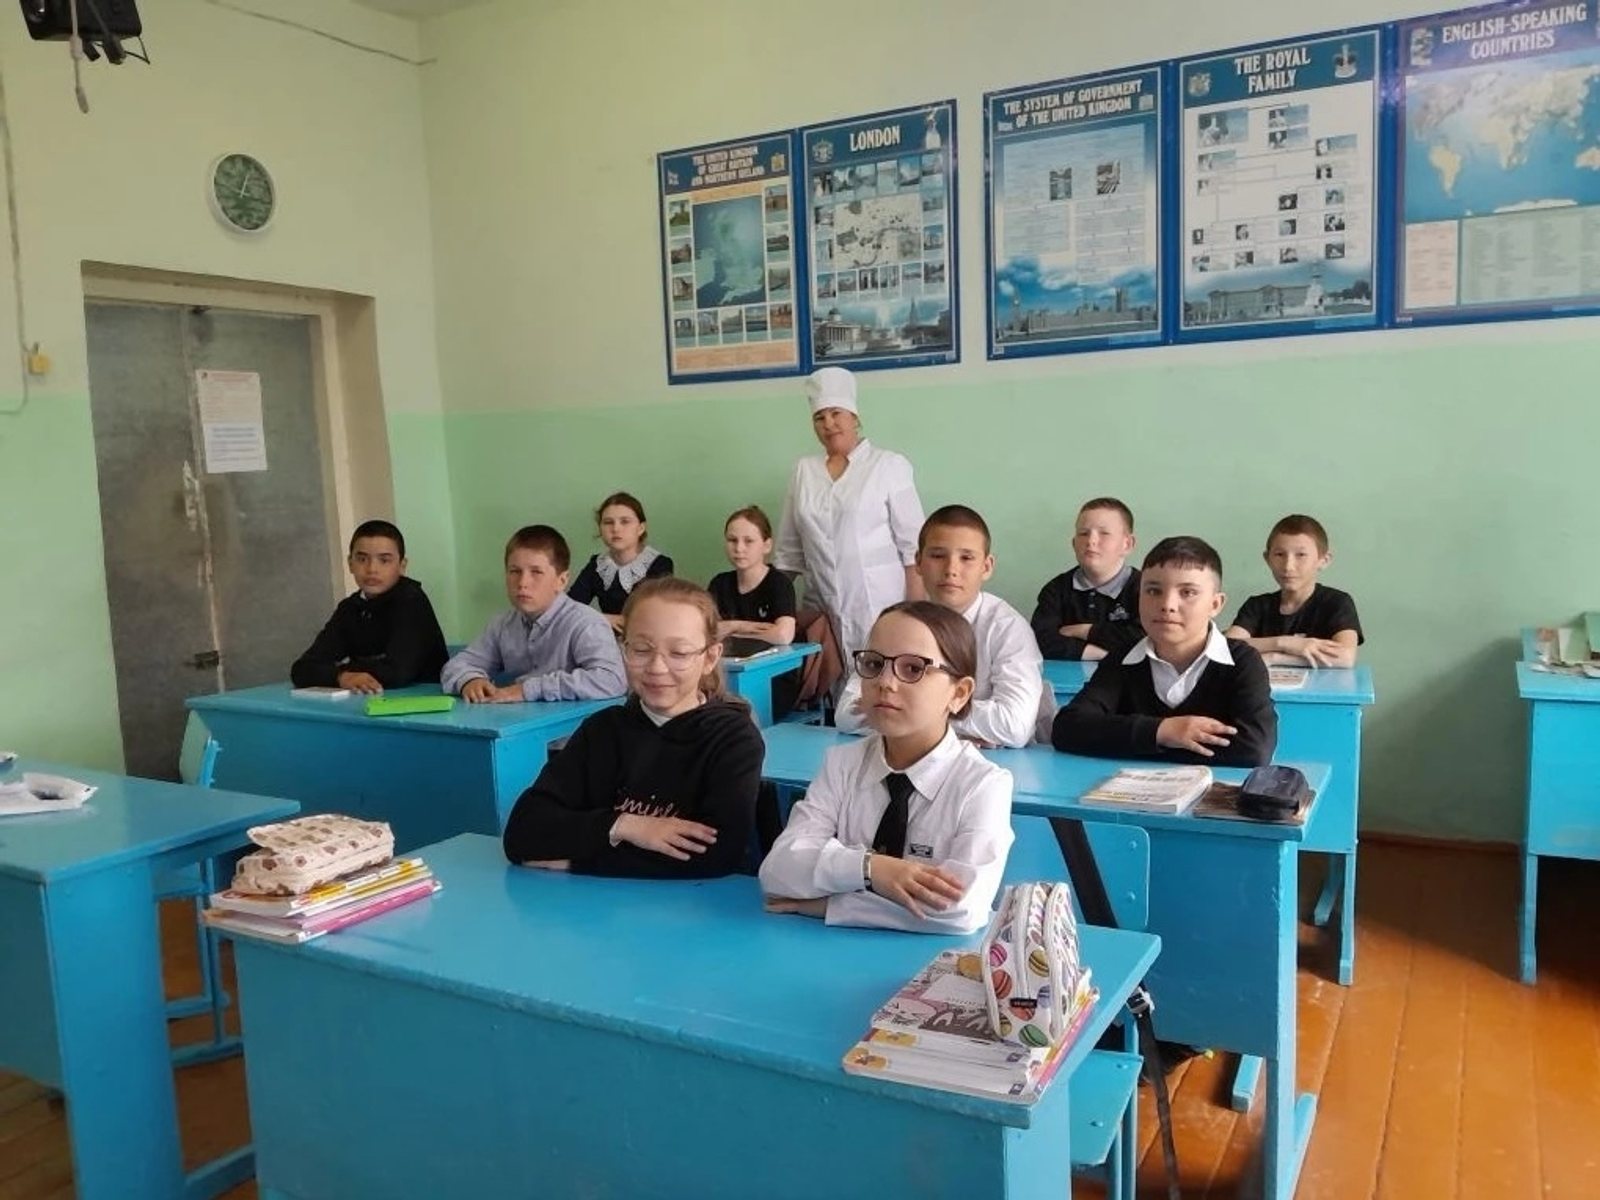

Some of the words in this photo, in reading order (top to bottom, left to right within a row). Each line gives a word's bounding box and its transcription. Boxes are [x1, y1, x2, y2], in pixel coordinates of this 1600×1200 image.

[1442, 3, 1587, 44] ENGLISH-SPEAKING
[1471, 30, 1555, 60] COUNTRIES
[1234, 55, 1261, 75] THE
[1265, 47, 1311, 71] ROYAL
[1248, 69, 1297, 94] FAMILY
[1003, 100, 1022, 115] THE
[1024, 93, 1060, 111] SYSTEM
[1063, 90, 1075, 104] OF
[1078, 79, 1143, 101] GOVERNMENT
[1016, 113, 1028, 128] OF
[1032, 110, 1050, 125] THE
[1052, 104, 1086, 122] UNITED
[1088, 96, 1132, 116] KINGDOM
[850, 125, 900, 152] LONDON
